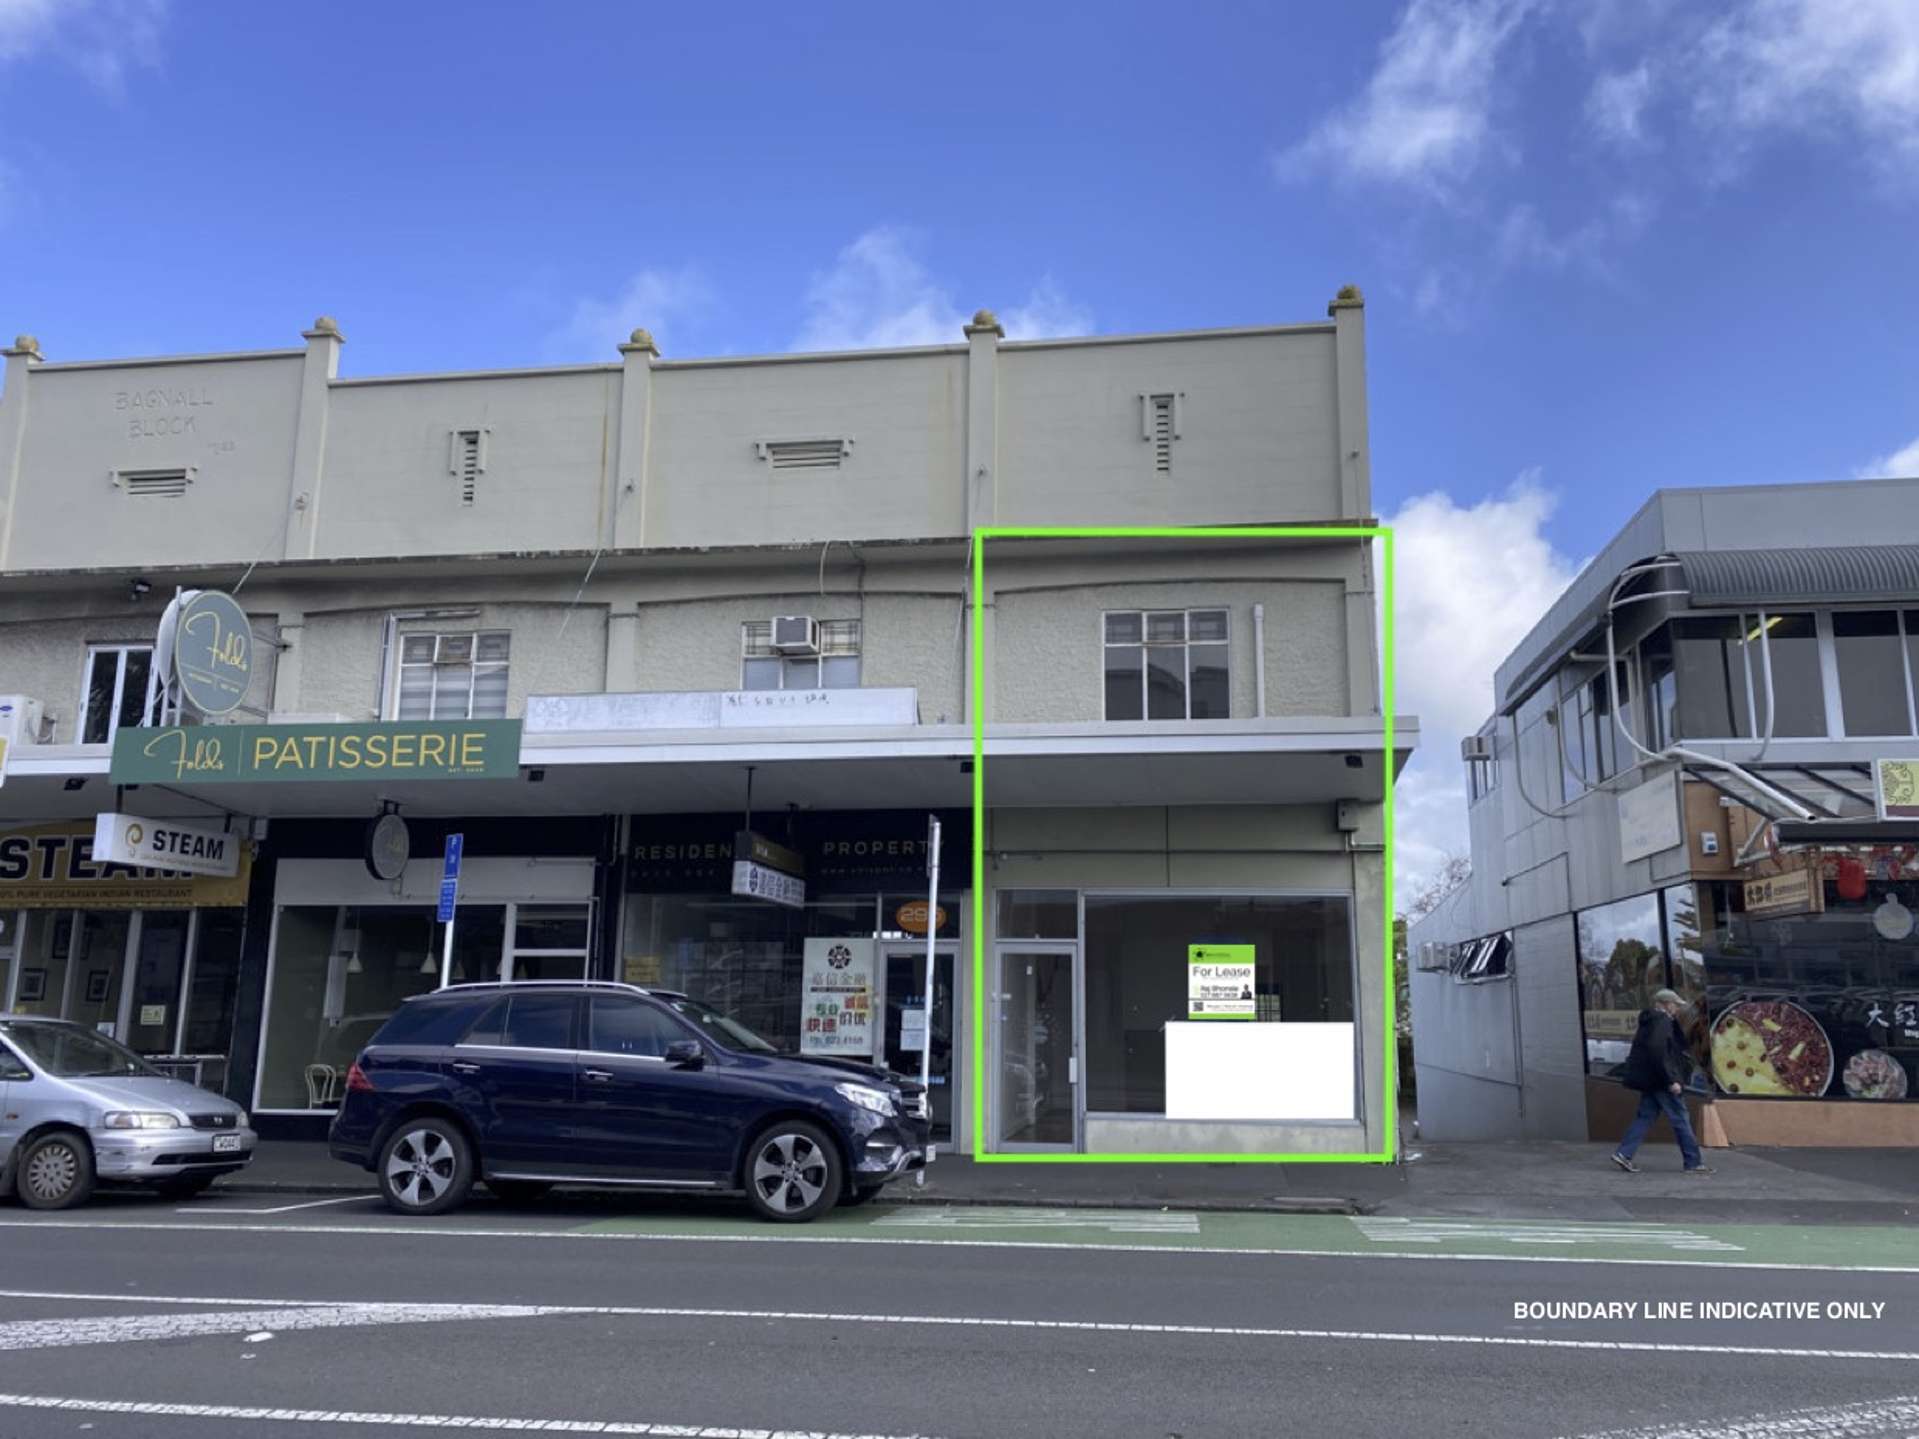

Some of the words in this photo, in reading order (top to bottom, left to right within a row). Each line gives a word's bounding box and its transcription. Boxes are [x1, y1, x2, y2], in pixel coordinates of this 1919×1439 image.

[114, 387, 215, 411] BAGNALL
[128, 415, 197, 438] BLOCK
[254, 733, 487, 769] PATISSERIE
[152, 829, 225, 861] STEAM
[633, 842, 734, 861] RESIDEN
[822, 840, 945, 857] PROPERT
[0, 836, 193, 881] STE
[132, 888, 193, 897] RESTAURANT
[1192, 965, 1212, 977] For
[1215, 965, 1251, 977] Lease
